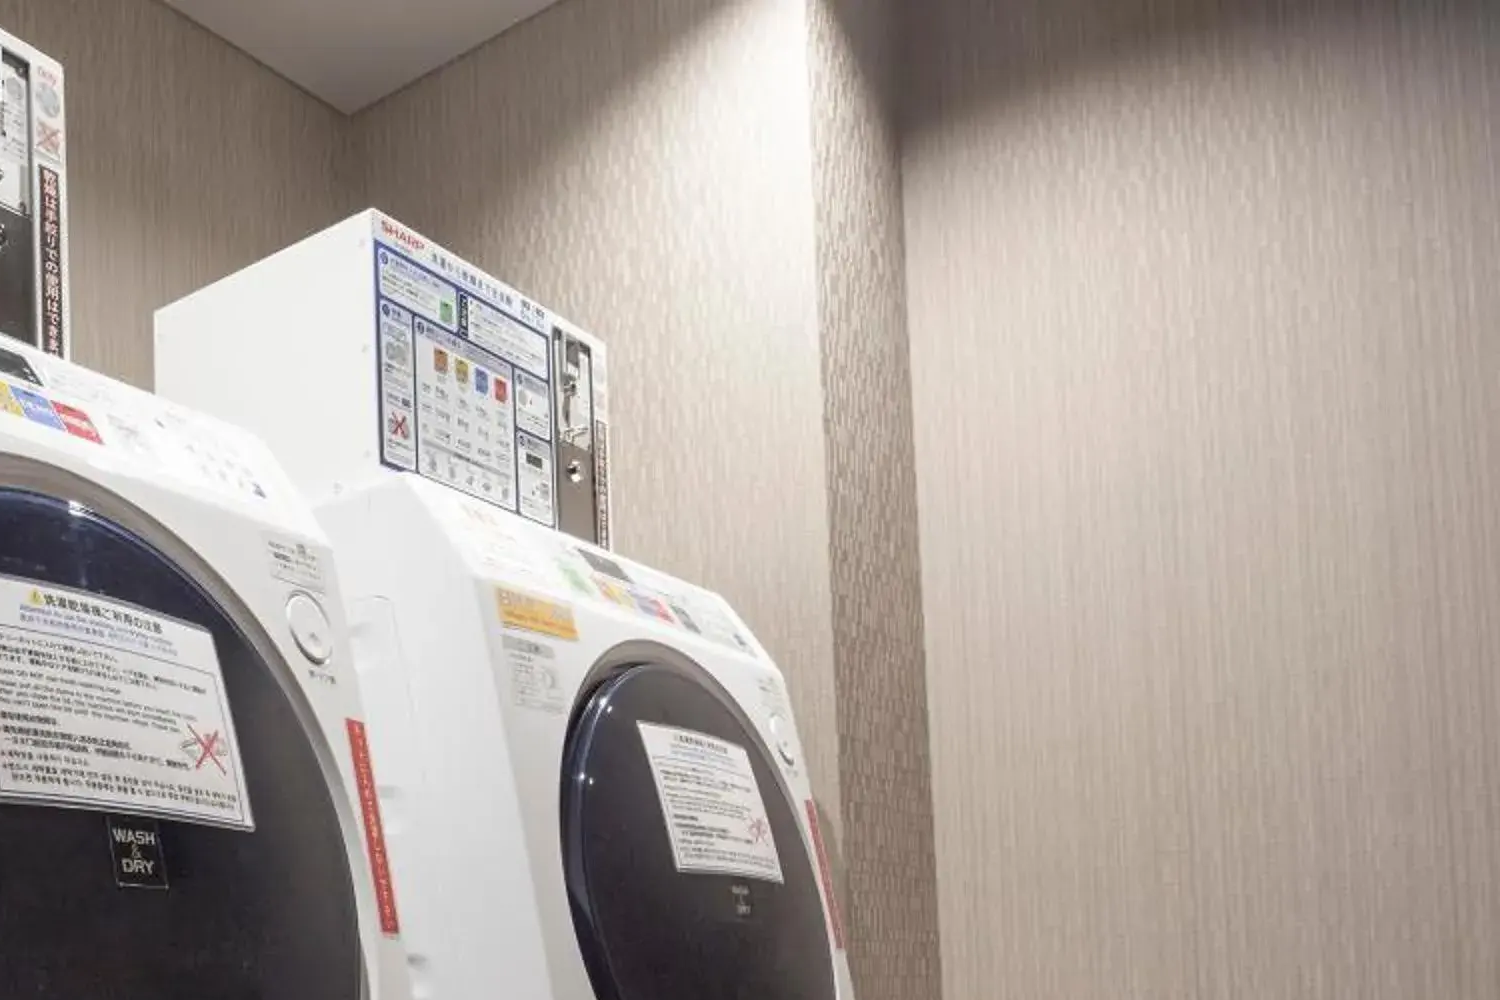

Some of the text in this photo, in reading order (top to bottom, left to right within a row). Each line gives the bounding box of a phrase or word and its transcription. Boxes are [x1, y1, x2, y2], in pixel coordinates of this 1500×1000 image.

[381, 220, 424, 250] SHARP
[112, 828, 155, 846] WASH
[131, 845, 141, 859] &
[121, 858, 155, 875] DRY
